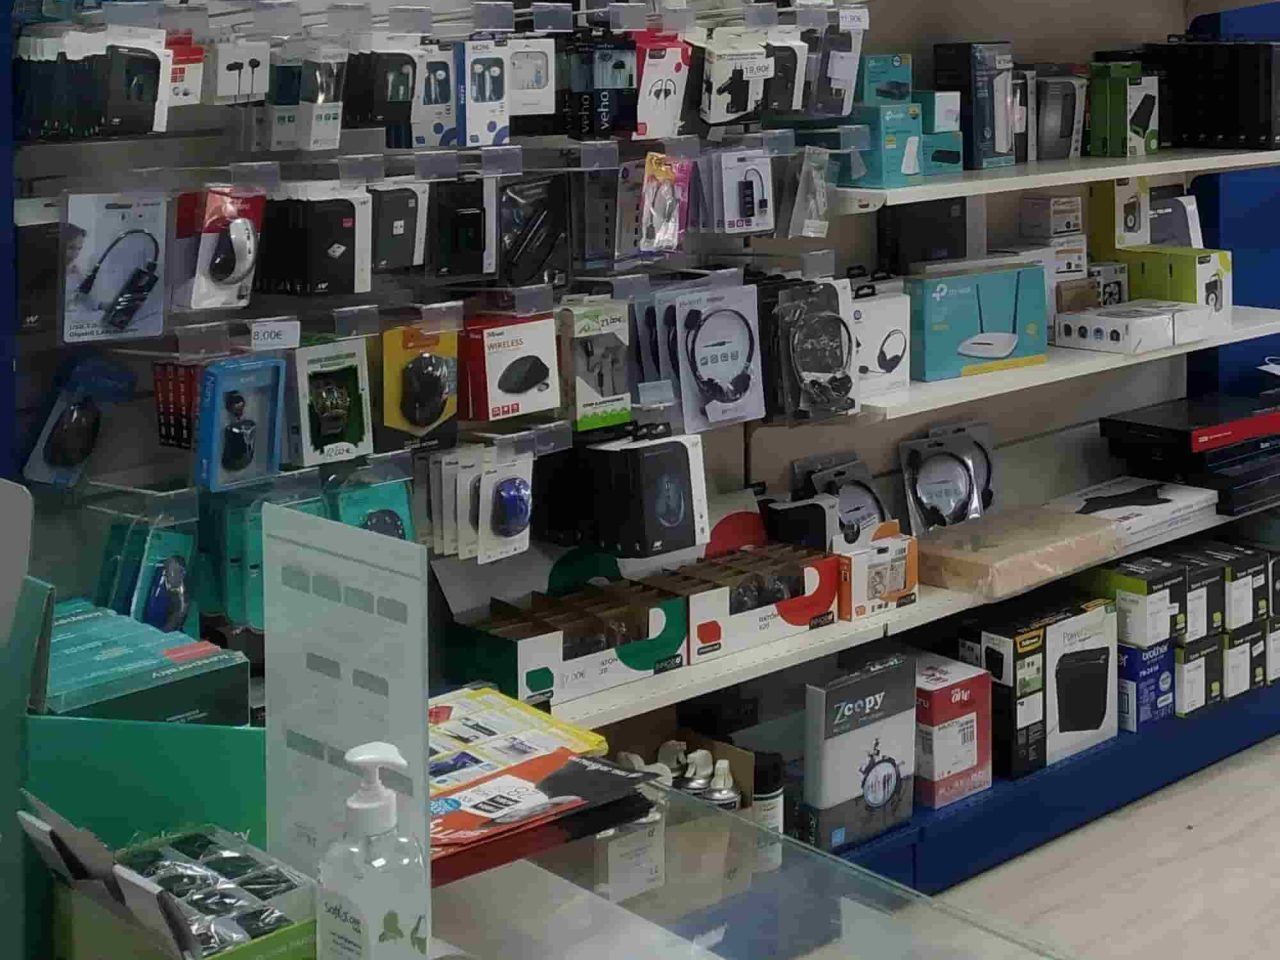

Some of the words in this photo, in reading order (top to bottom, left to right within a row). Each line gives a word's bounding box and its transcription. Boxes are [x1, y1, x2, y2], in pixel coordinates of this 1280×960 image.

[582, 94, 590, 133] veho
[600, 91, 610, 130] veho
[487, 338, 524, 352] WIRELESS
[1142, 641, 1170, 661] brother
